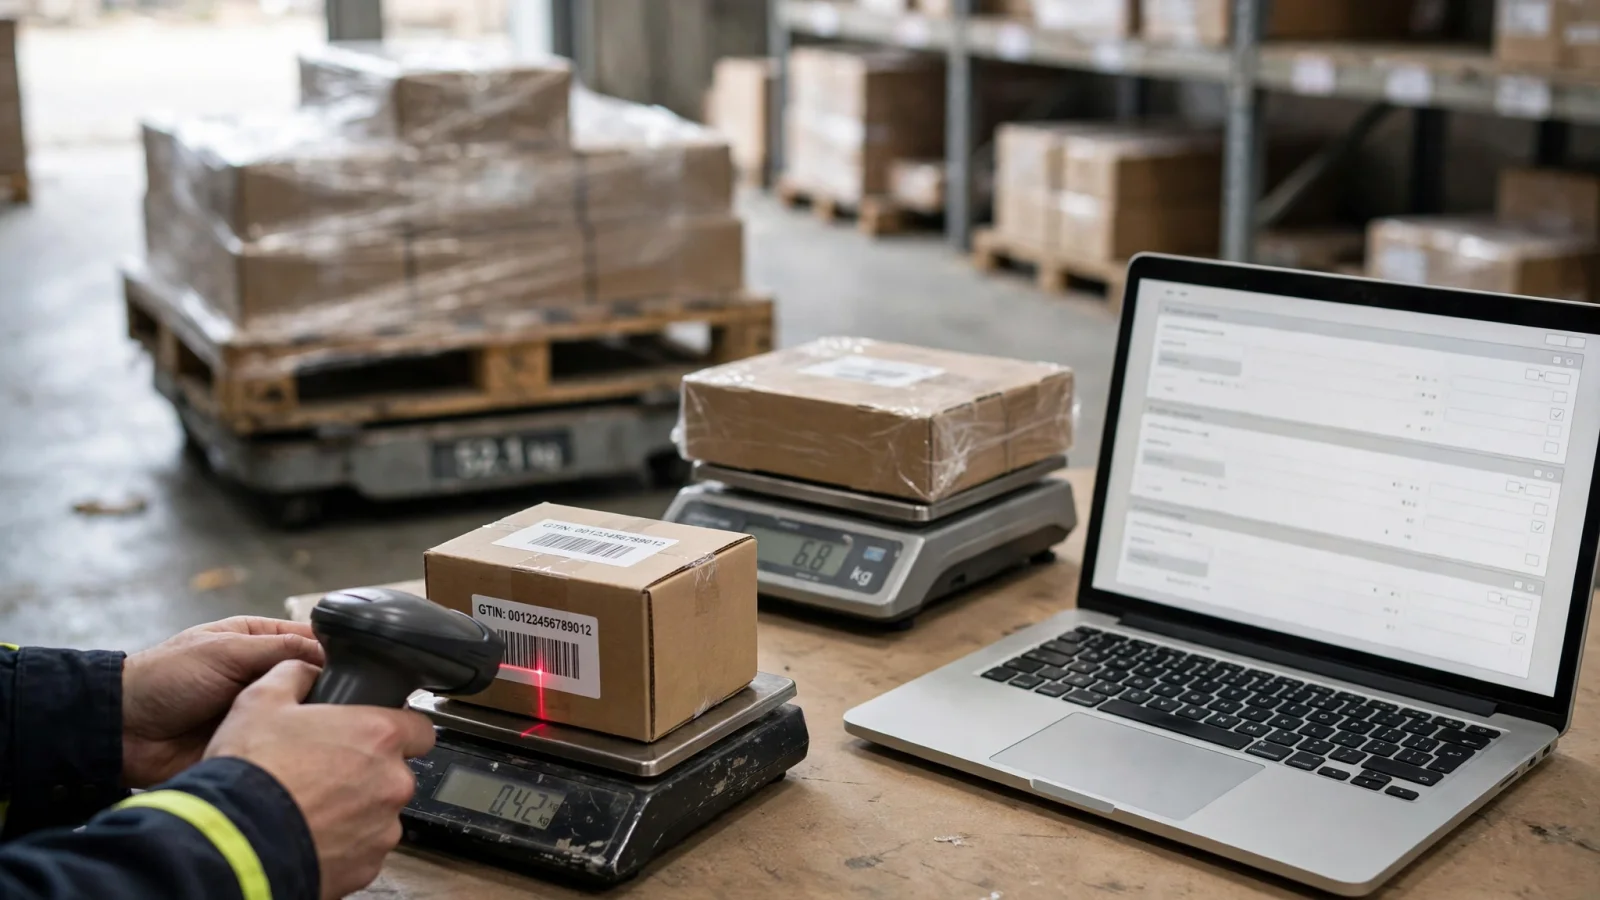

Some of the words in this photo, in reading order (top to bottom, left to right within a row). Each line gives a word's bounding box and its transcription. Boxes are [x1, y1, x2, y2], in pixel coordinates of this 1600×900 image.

[849, 567, 873, 586] kg
[478, 604, 506, 619] GTIN:
[488, 785, 549, 823] 0.42
